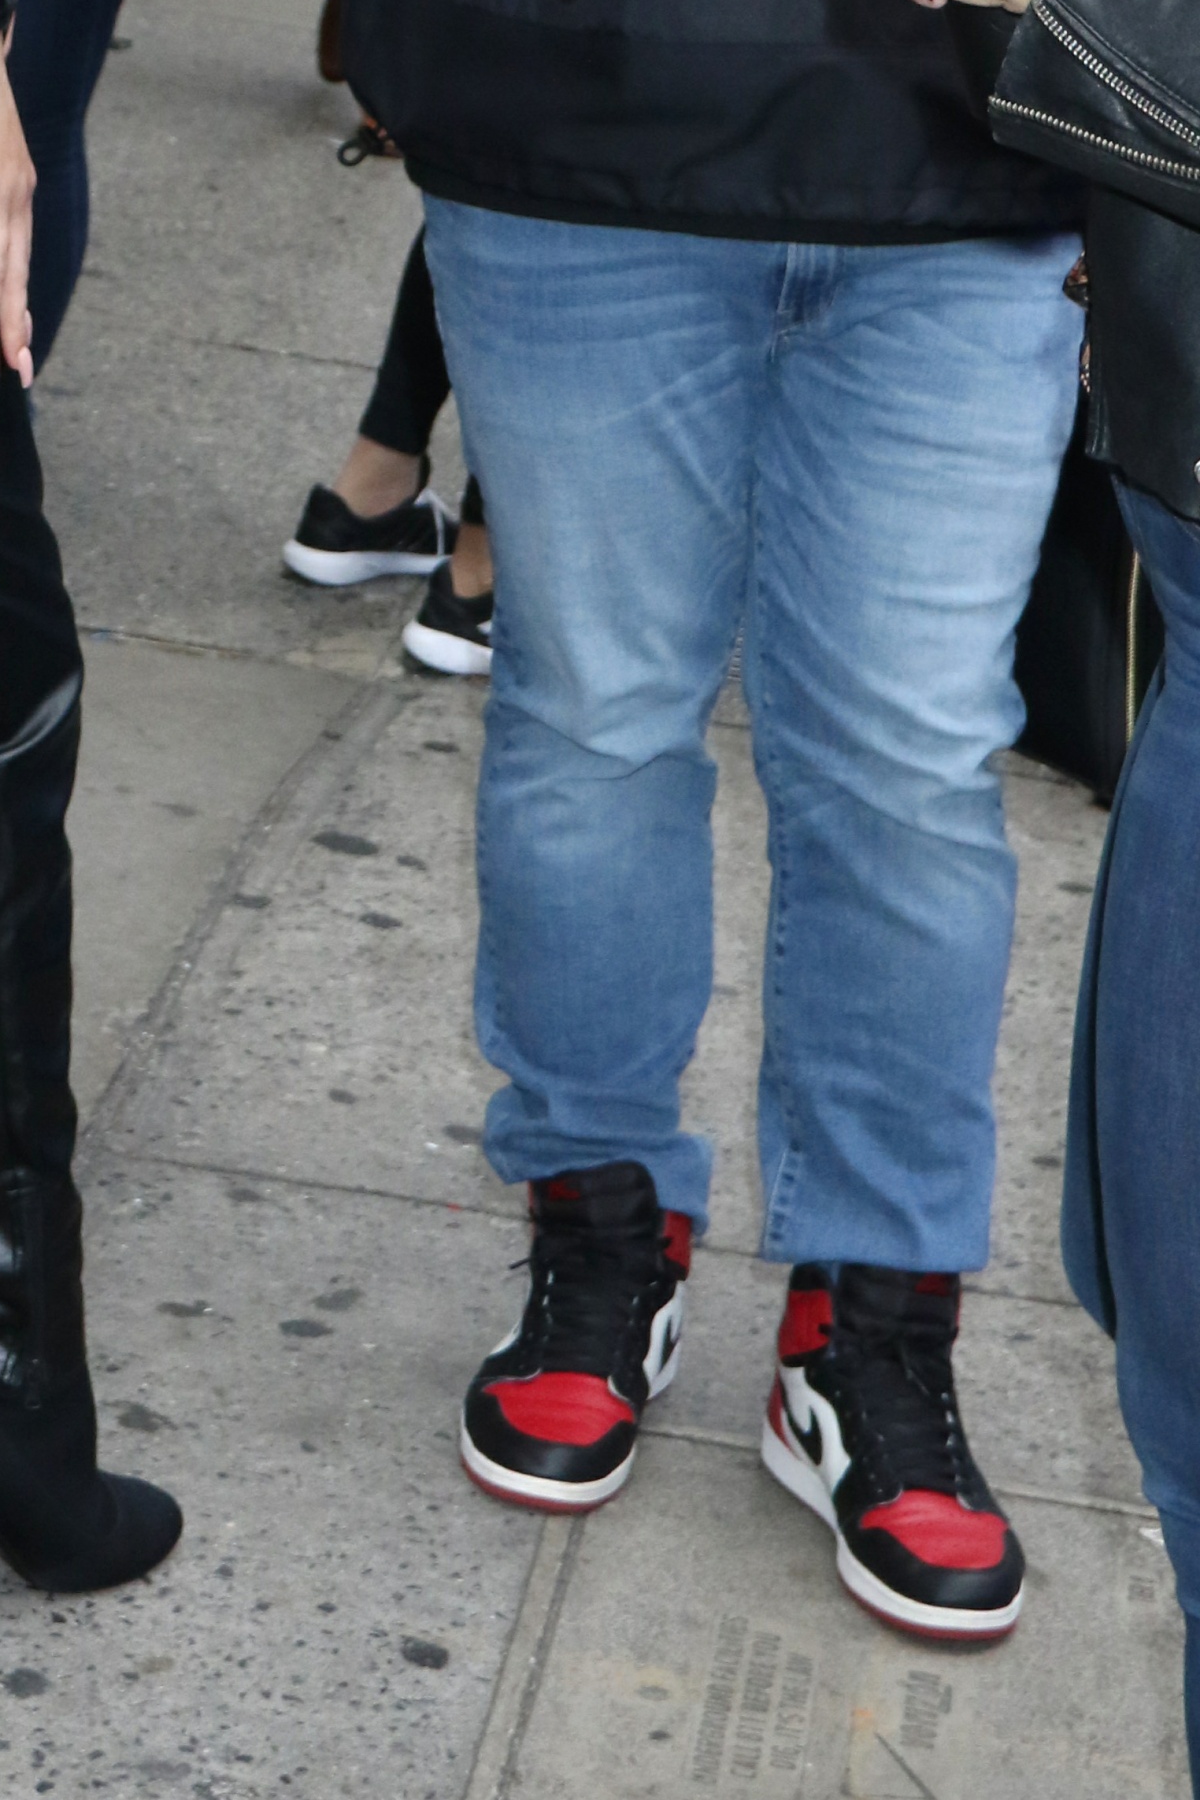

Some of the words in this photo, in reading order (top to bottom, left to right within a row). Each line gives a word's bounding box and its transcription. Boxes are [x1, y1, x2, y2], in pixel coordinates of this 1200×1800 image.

[751, 1631, 781, 1659] YOU
[741, 1661, 774, 1713] BEFORE
[779, 1686, 810, 1711] THE
[691, 1683, 734, 1784] UNDERGROUND
[730, 1746, 761, 1779] CALL
